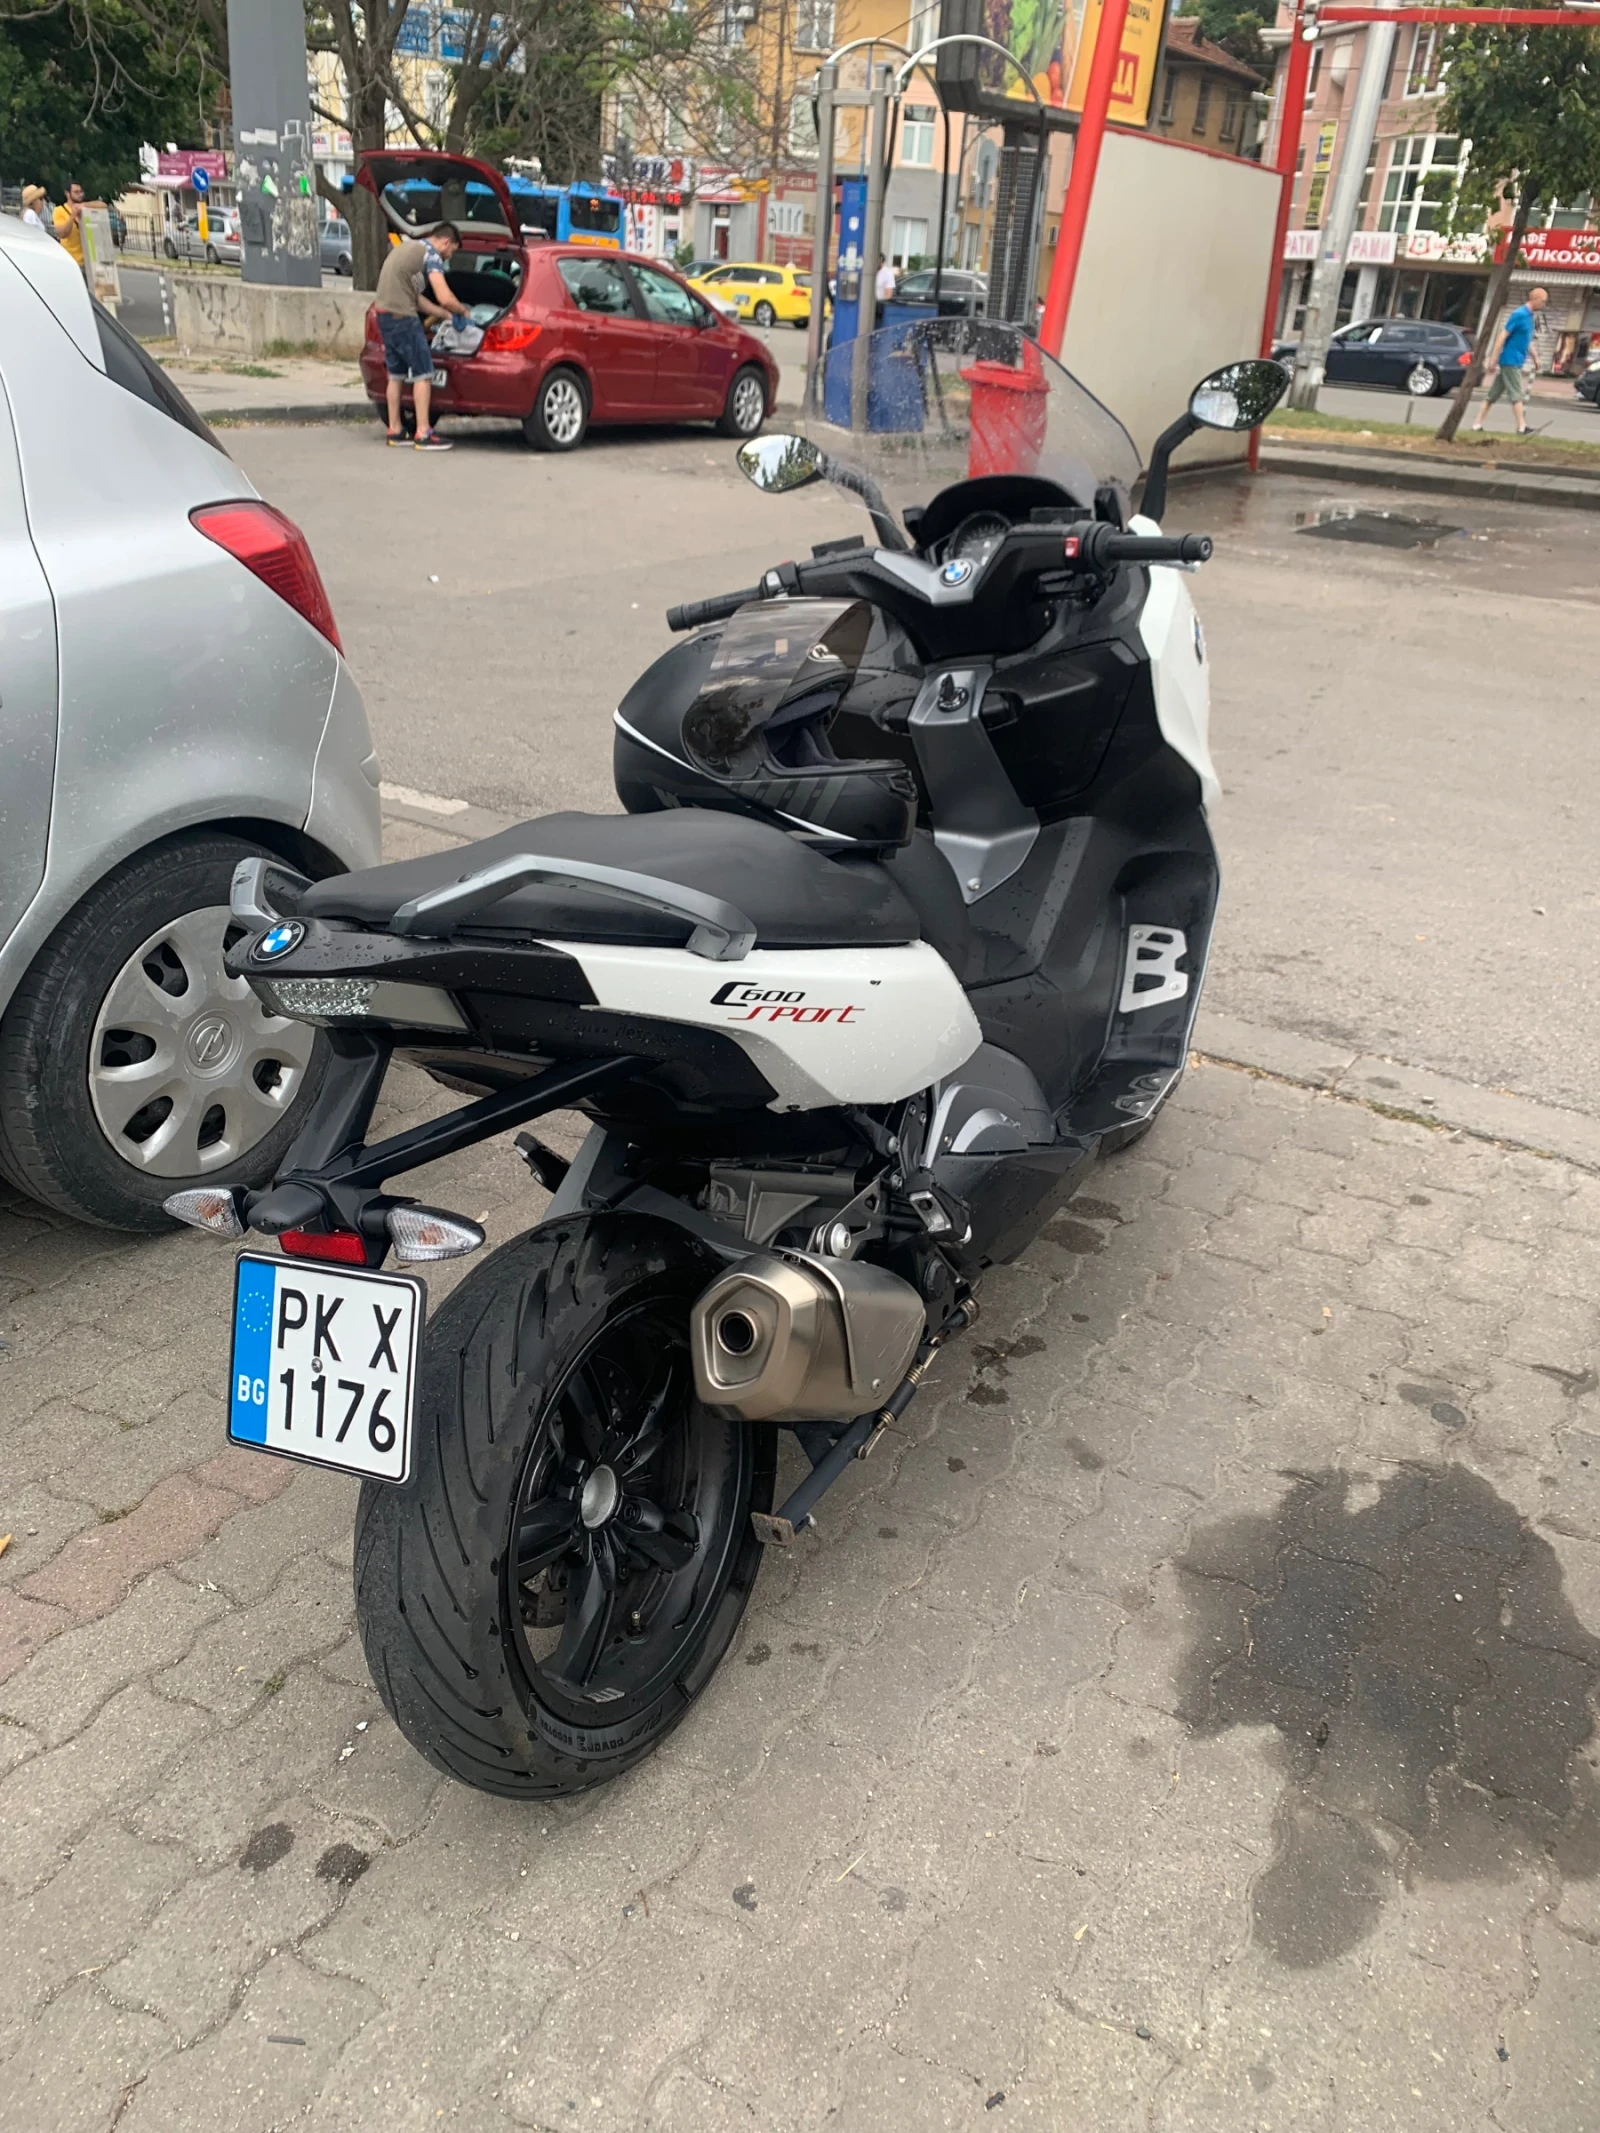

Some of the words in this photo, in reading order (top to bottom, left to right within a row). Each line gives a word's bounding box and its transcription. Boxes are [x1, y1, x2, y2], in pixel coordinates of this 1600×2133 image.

[1127, 3, 1151, 22] ОШУРА
[1285, 234, 1314, 255] РАТИ
[1351, 235, 1391, 259] РАМИ
[1568, 234, 1600, 250] ЦИГ
[1518, 247, 1600, 266] АЛКОХО
[710, 981, 806, 1007] C600
[277, 1286, 345, 1363] PK
[368, 1303, 403, 1374] X
[236, 1373, 266, 1406] BG
[280, 1367, 397, 1453] 1176
